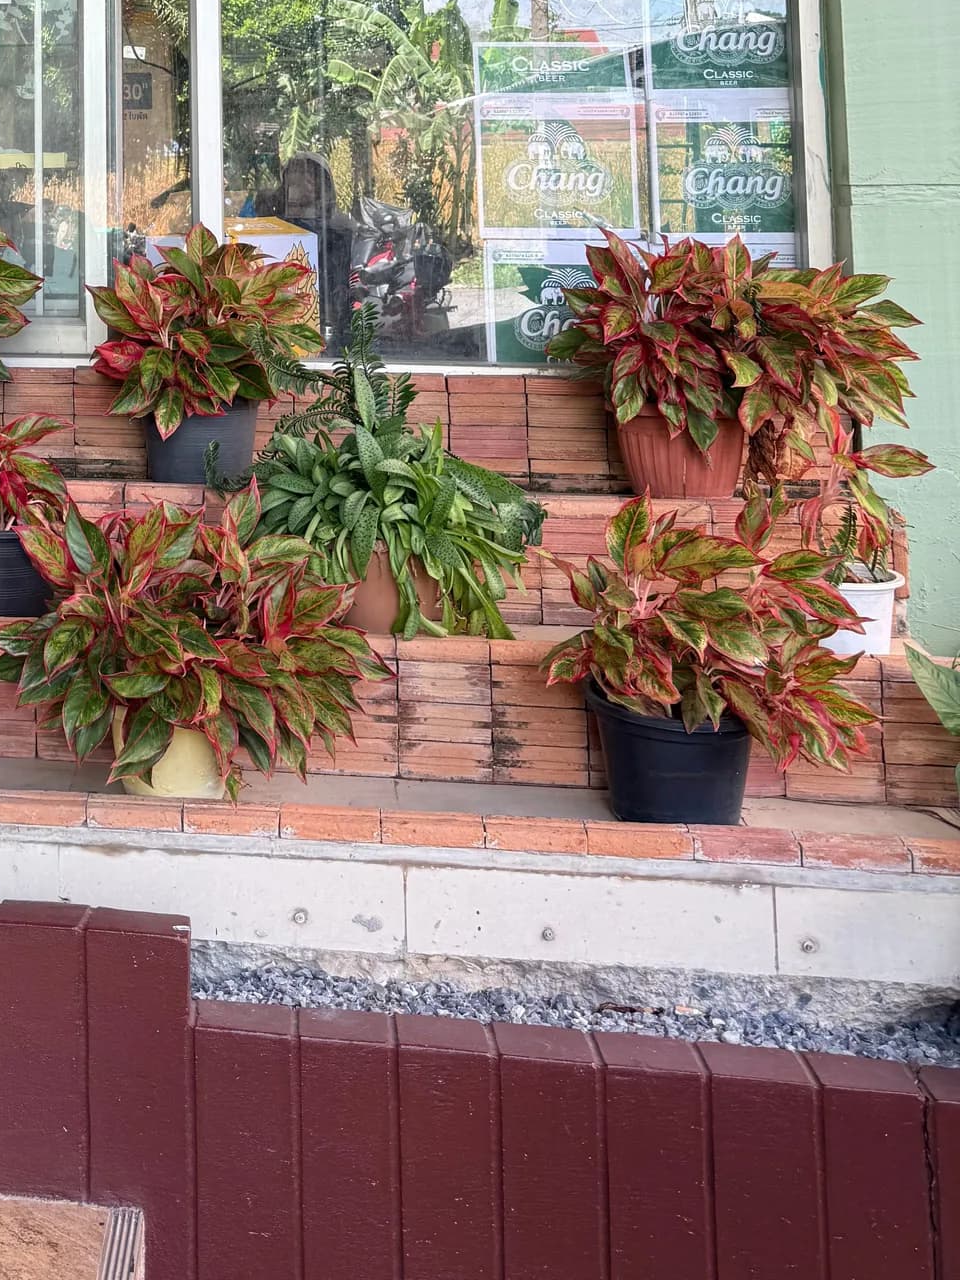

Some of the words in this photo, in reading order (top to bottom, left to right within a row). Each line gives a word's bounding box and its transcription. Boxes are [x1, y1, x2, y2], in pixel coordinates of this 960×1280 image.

[676, 24, 777, 56] Chang
[512, 56, 590, 73] CLASSIC
[538, 74, 566, 82] BEER
[703, 68, 754, 79] CLASSIC
[507, 163, 607, 197] Chang
[685, 167, 784, 200] Chang
[534, 208, 584, 219] CLASSIC
[712, 212, 762, 223] CLASSIC
